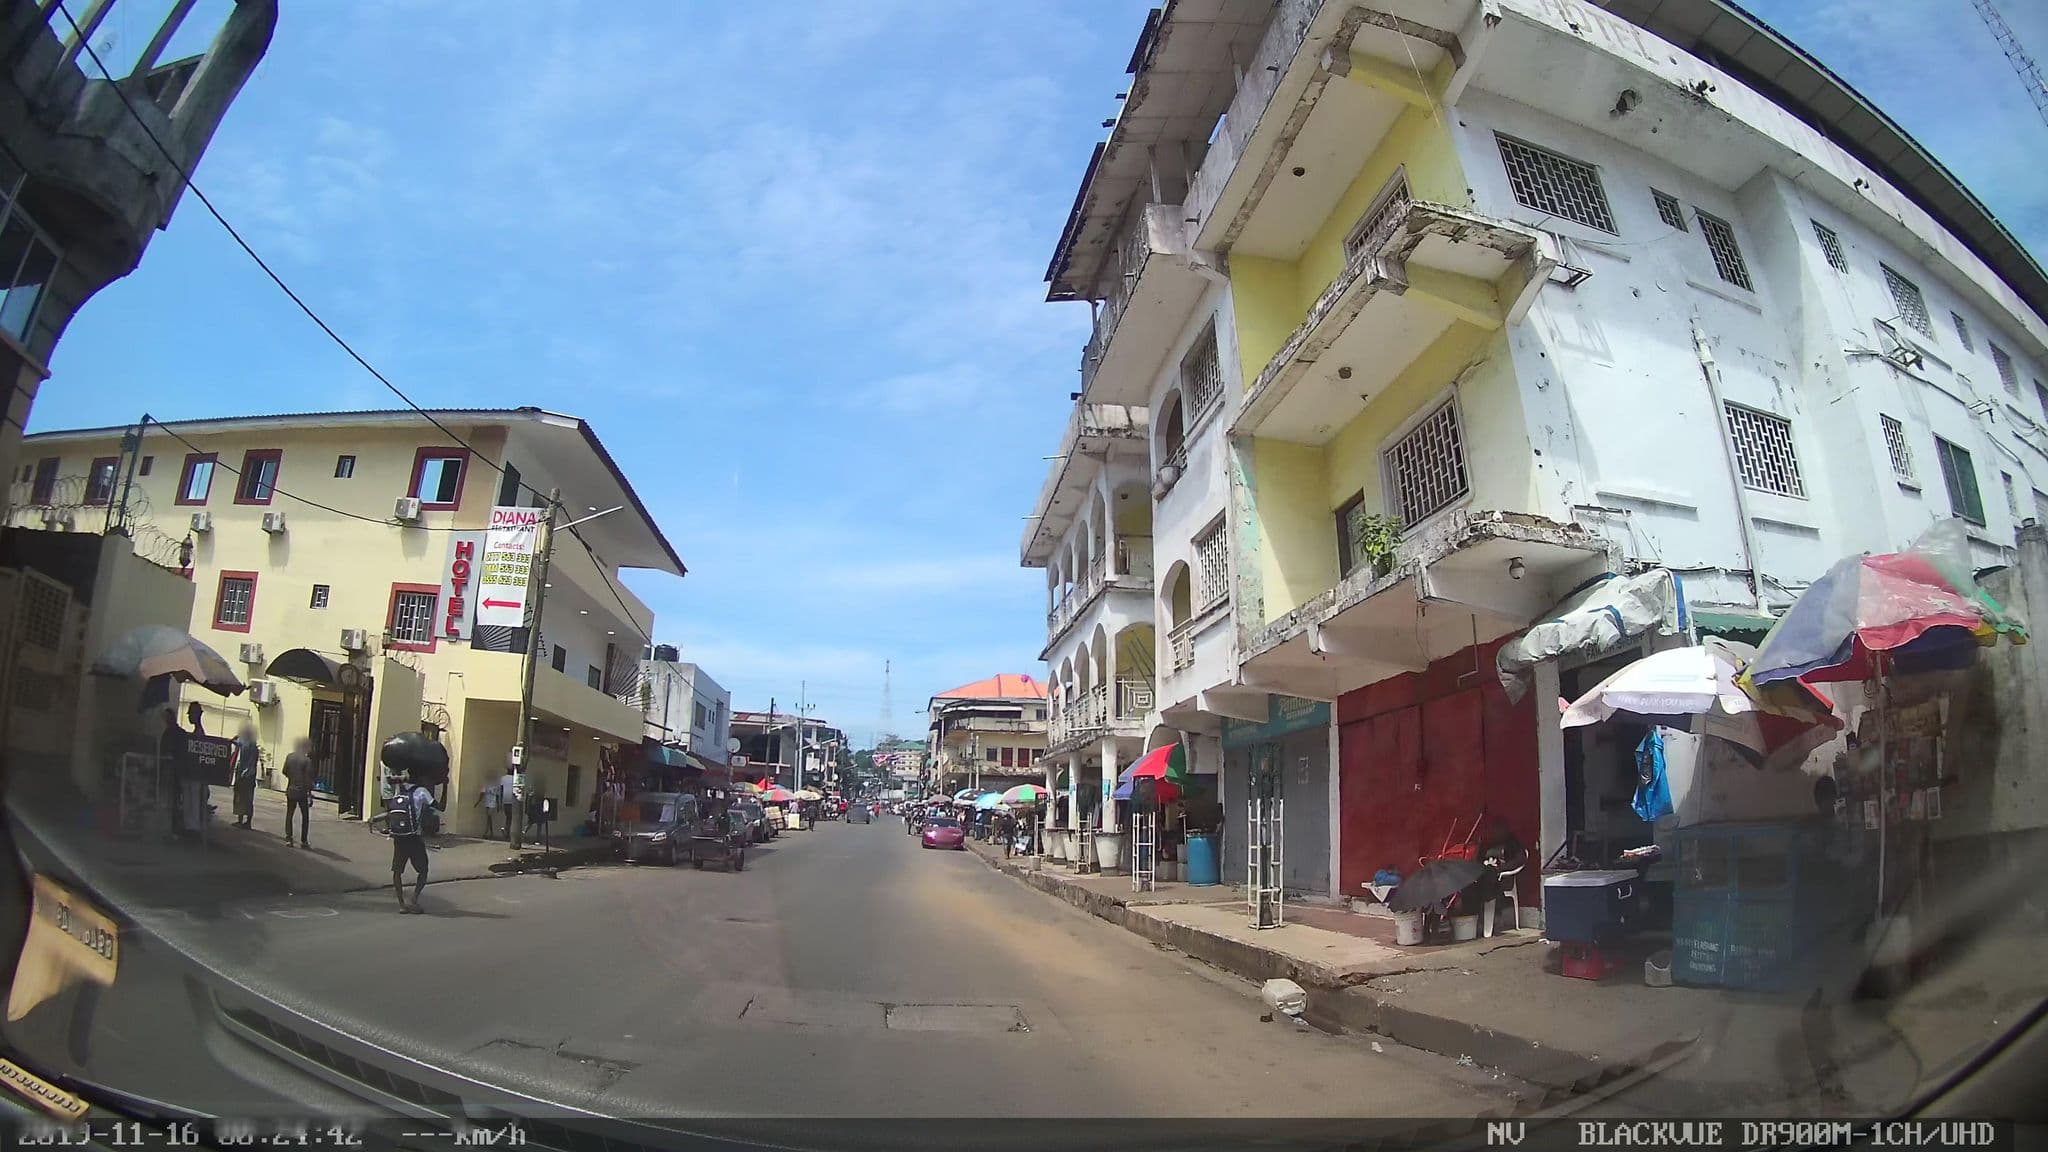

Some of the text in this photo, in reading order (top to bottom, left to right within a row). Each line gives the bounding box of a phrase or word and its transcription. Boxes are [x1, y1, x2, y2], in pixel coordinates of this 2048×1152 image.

[493, 511, 537, 525] DIANA
[445, 541, 474, 636] HOTEL
[188, 740, 228, 758] RESERVED
[199, 756, 216, 765] FOR
